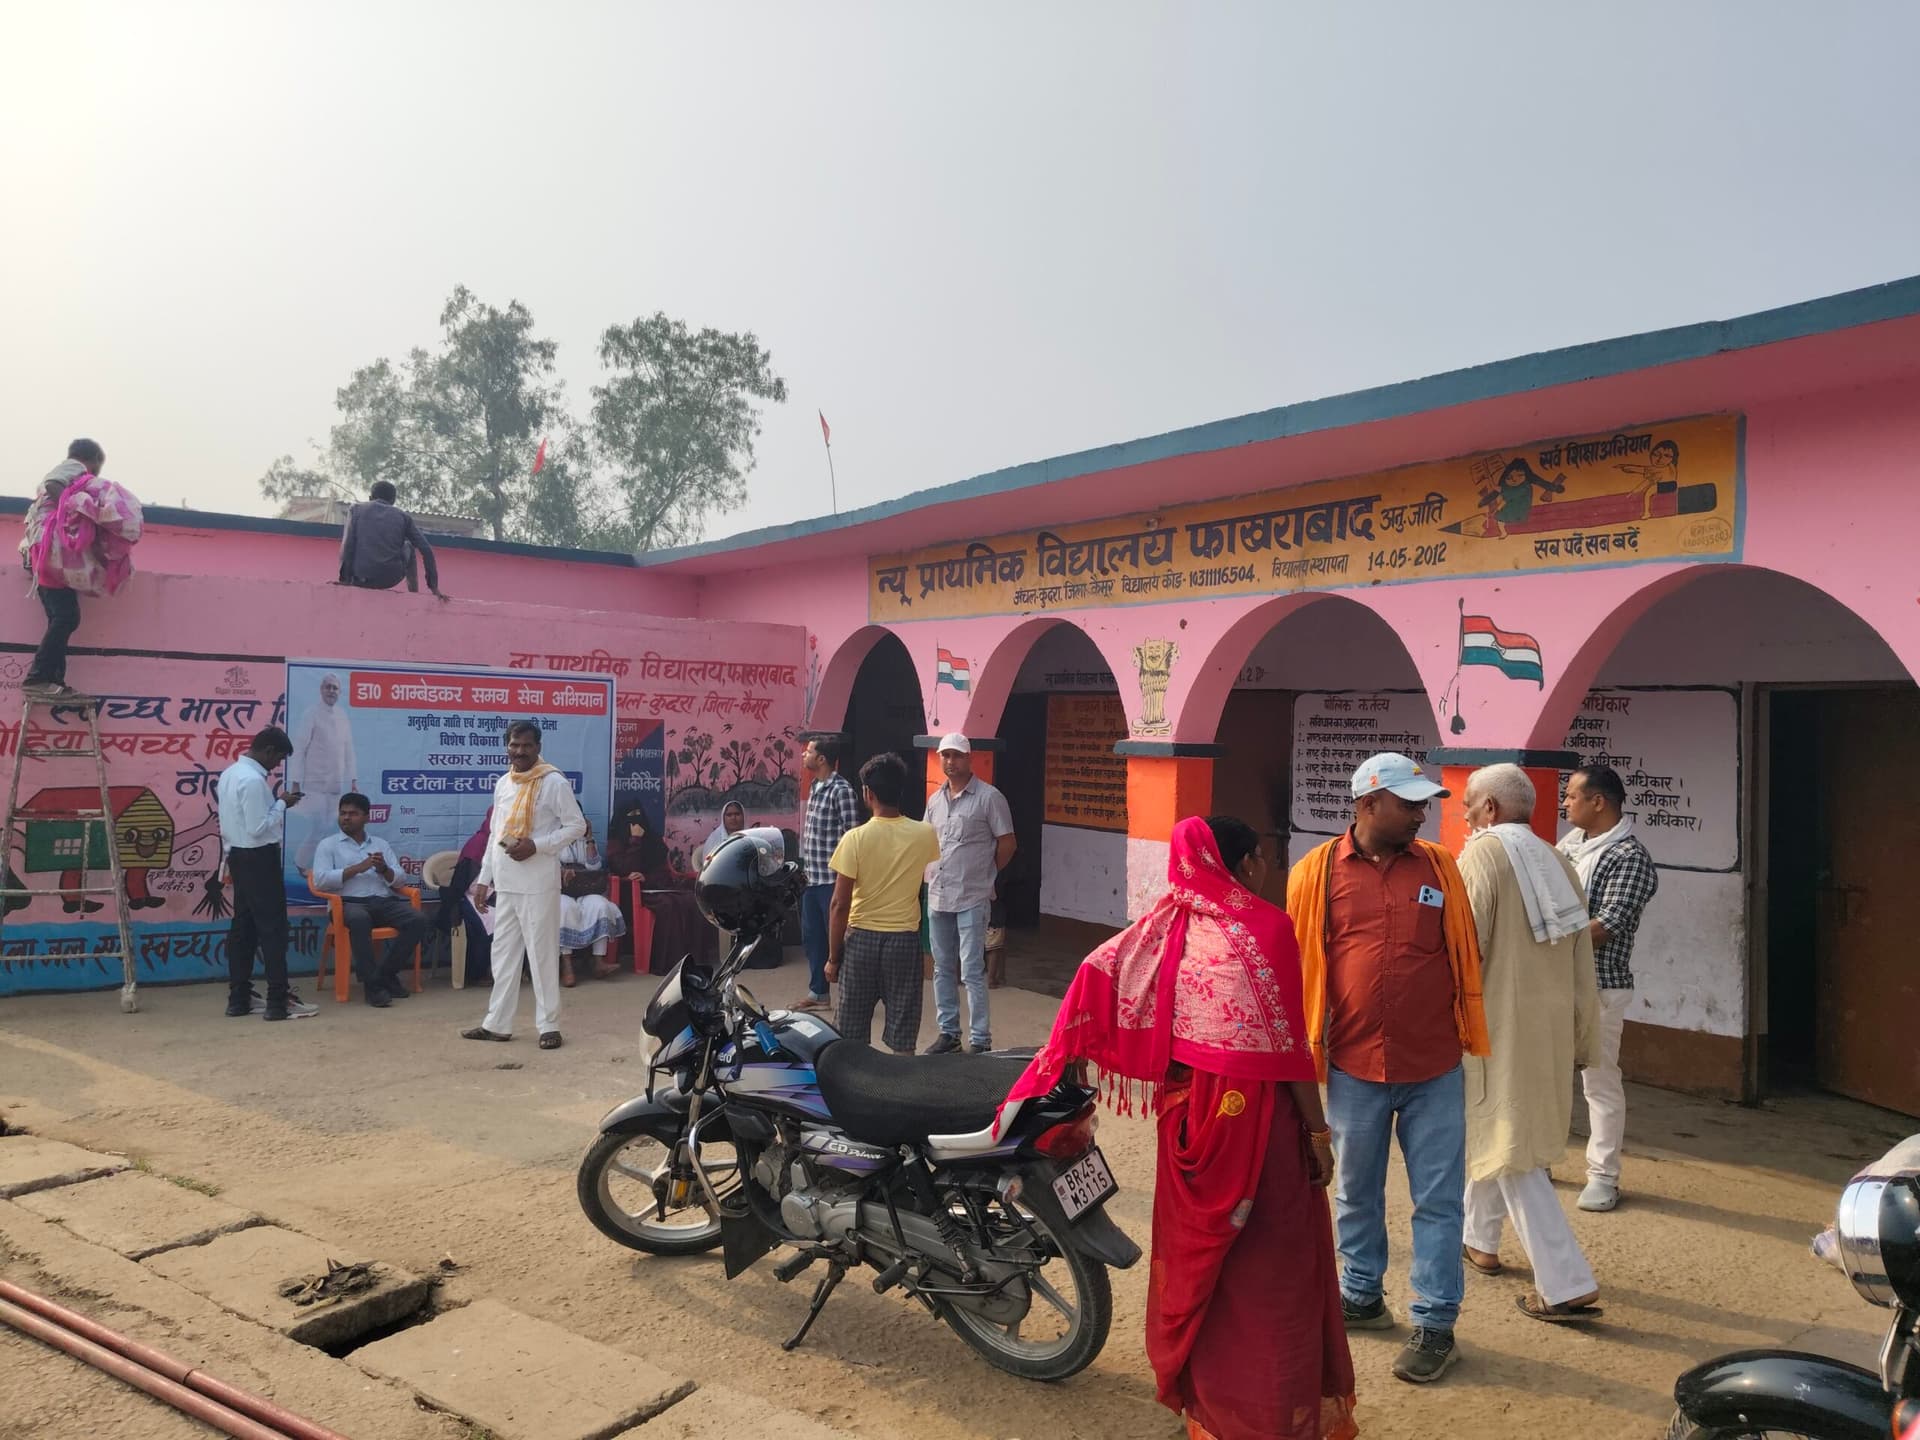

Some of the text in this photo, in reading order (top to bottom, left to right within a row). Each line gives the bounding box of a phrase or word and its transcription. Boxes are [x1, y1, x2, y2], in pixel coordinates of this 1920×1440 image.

[876, 565, 912, 606] न्यू
[917, 542, 1027, 599] प्राथमिक
[1036, 528, 1178, 577] विद्यालय
[1185, 494, 1382, 560] फाखराबाद
[391, 678, 463, 703] आम्बेडकर
[471, 687, 509, 705] समग्र
[518, 684, 545, 707] सेवा
[552, 685, 604, 708] अभियान
[179, 698, 262, 729] भारत
[407, 713, 441, 731] अनुसूचित
[443, 714, 461, 729] जाति
[541, 718, 558, 731] टोला
[440, 732, 466, 746] विशेष
[469, 732, 500, 747] विकास
[428, 753, 473, 767] सरकार
[388, 777, 409, 792] हर
[1624, 769, 1673, 791] अधिकार
[1631, 789, 1680, 810] अधिकार
[1064, 1157, 1096, 1191] BR45
